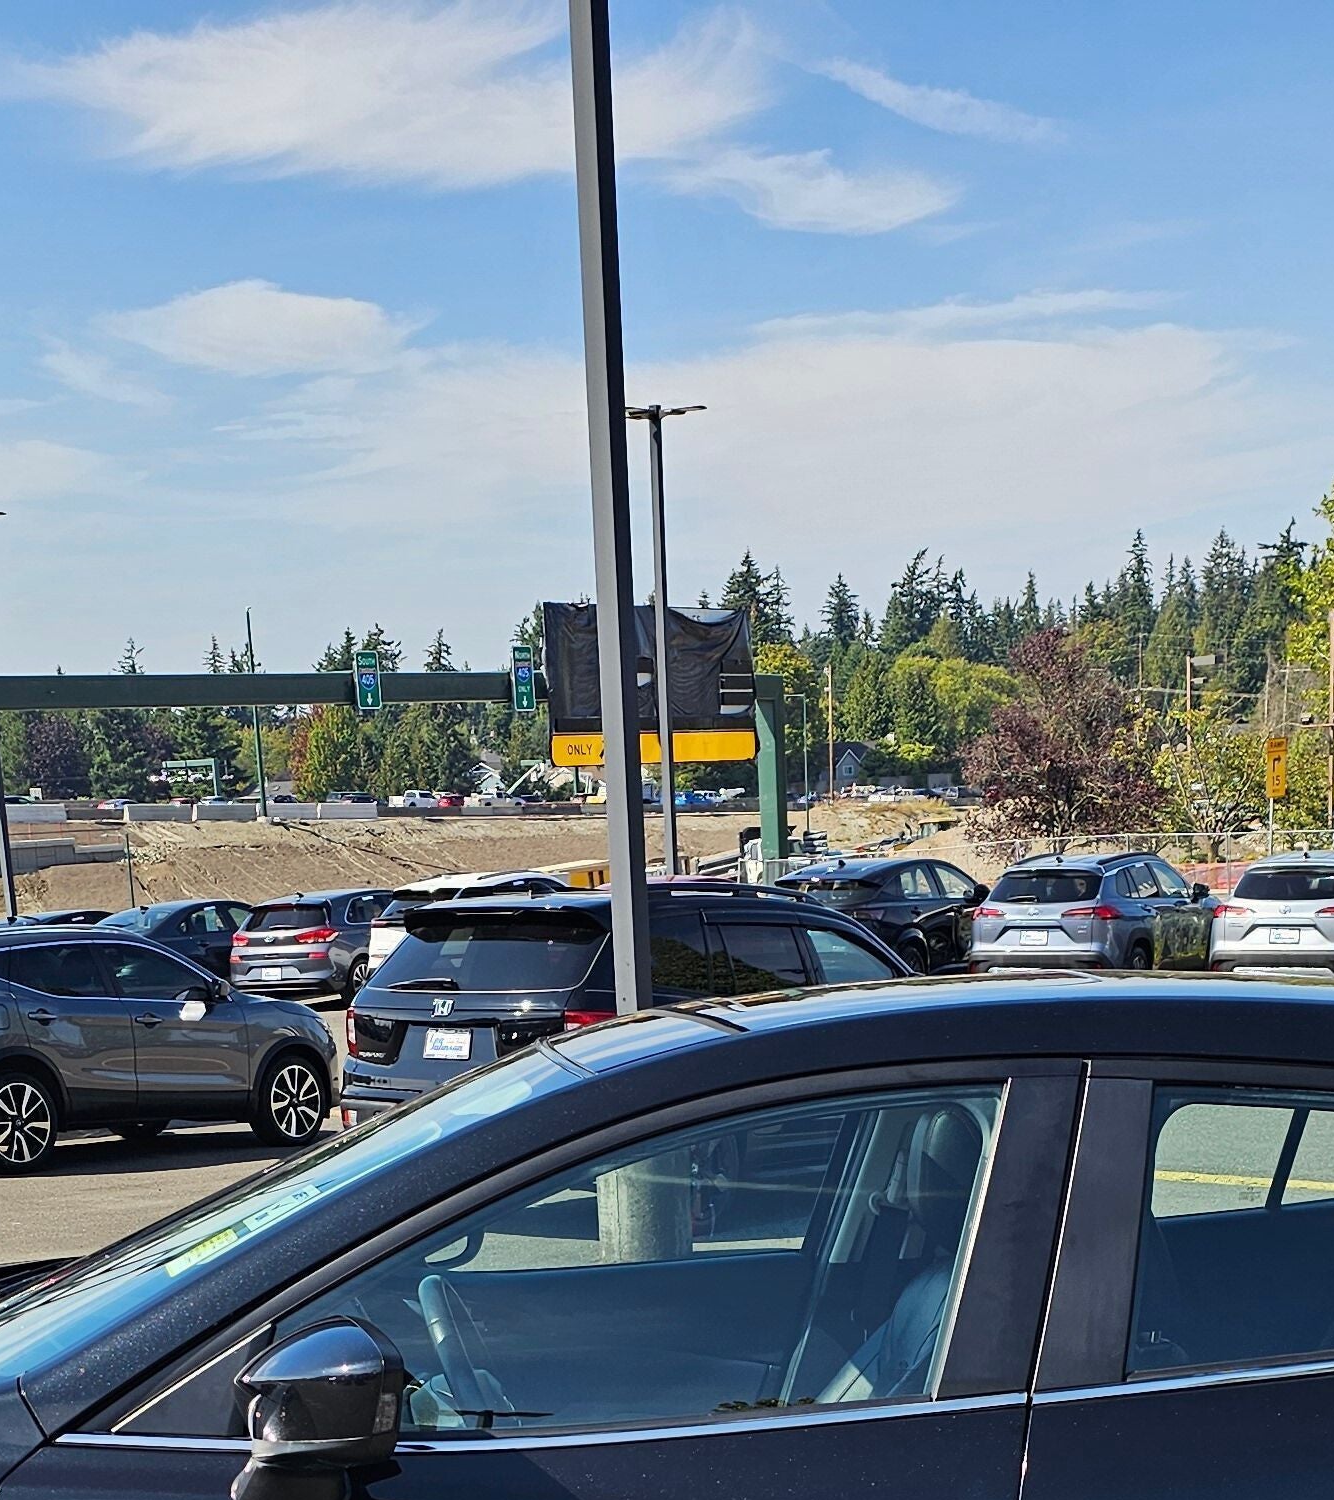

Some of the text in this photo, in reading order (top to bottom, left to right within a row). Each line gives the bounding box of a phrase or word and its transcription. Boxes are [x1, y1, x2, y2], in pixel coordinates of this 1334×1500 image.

[518, 667, 530, 678] 405
[361, 673, 375, 685] 405
[567, 743, 593, 756] ONLY
